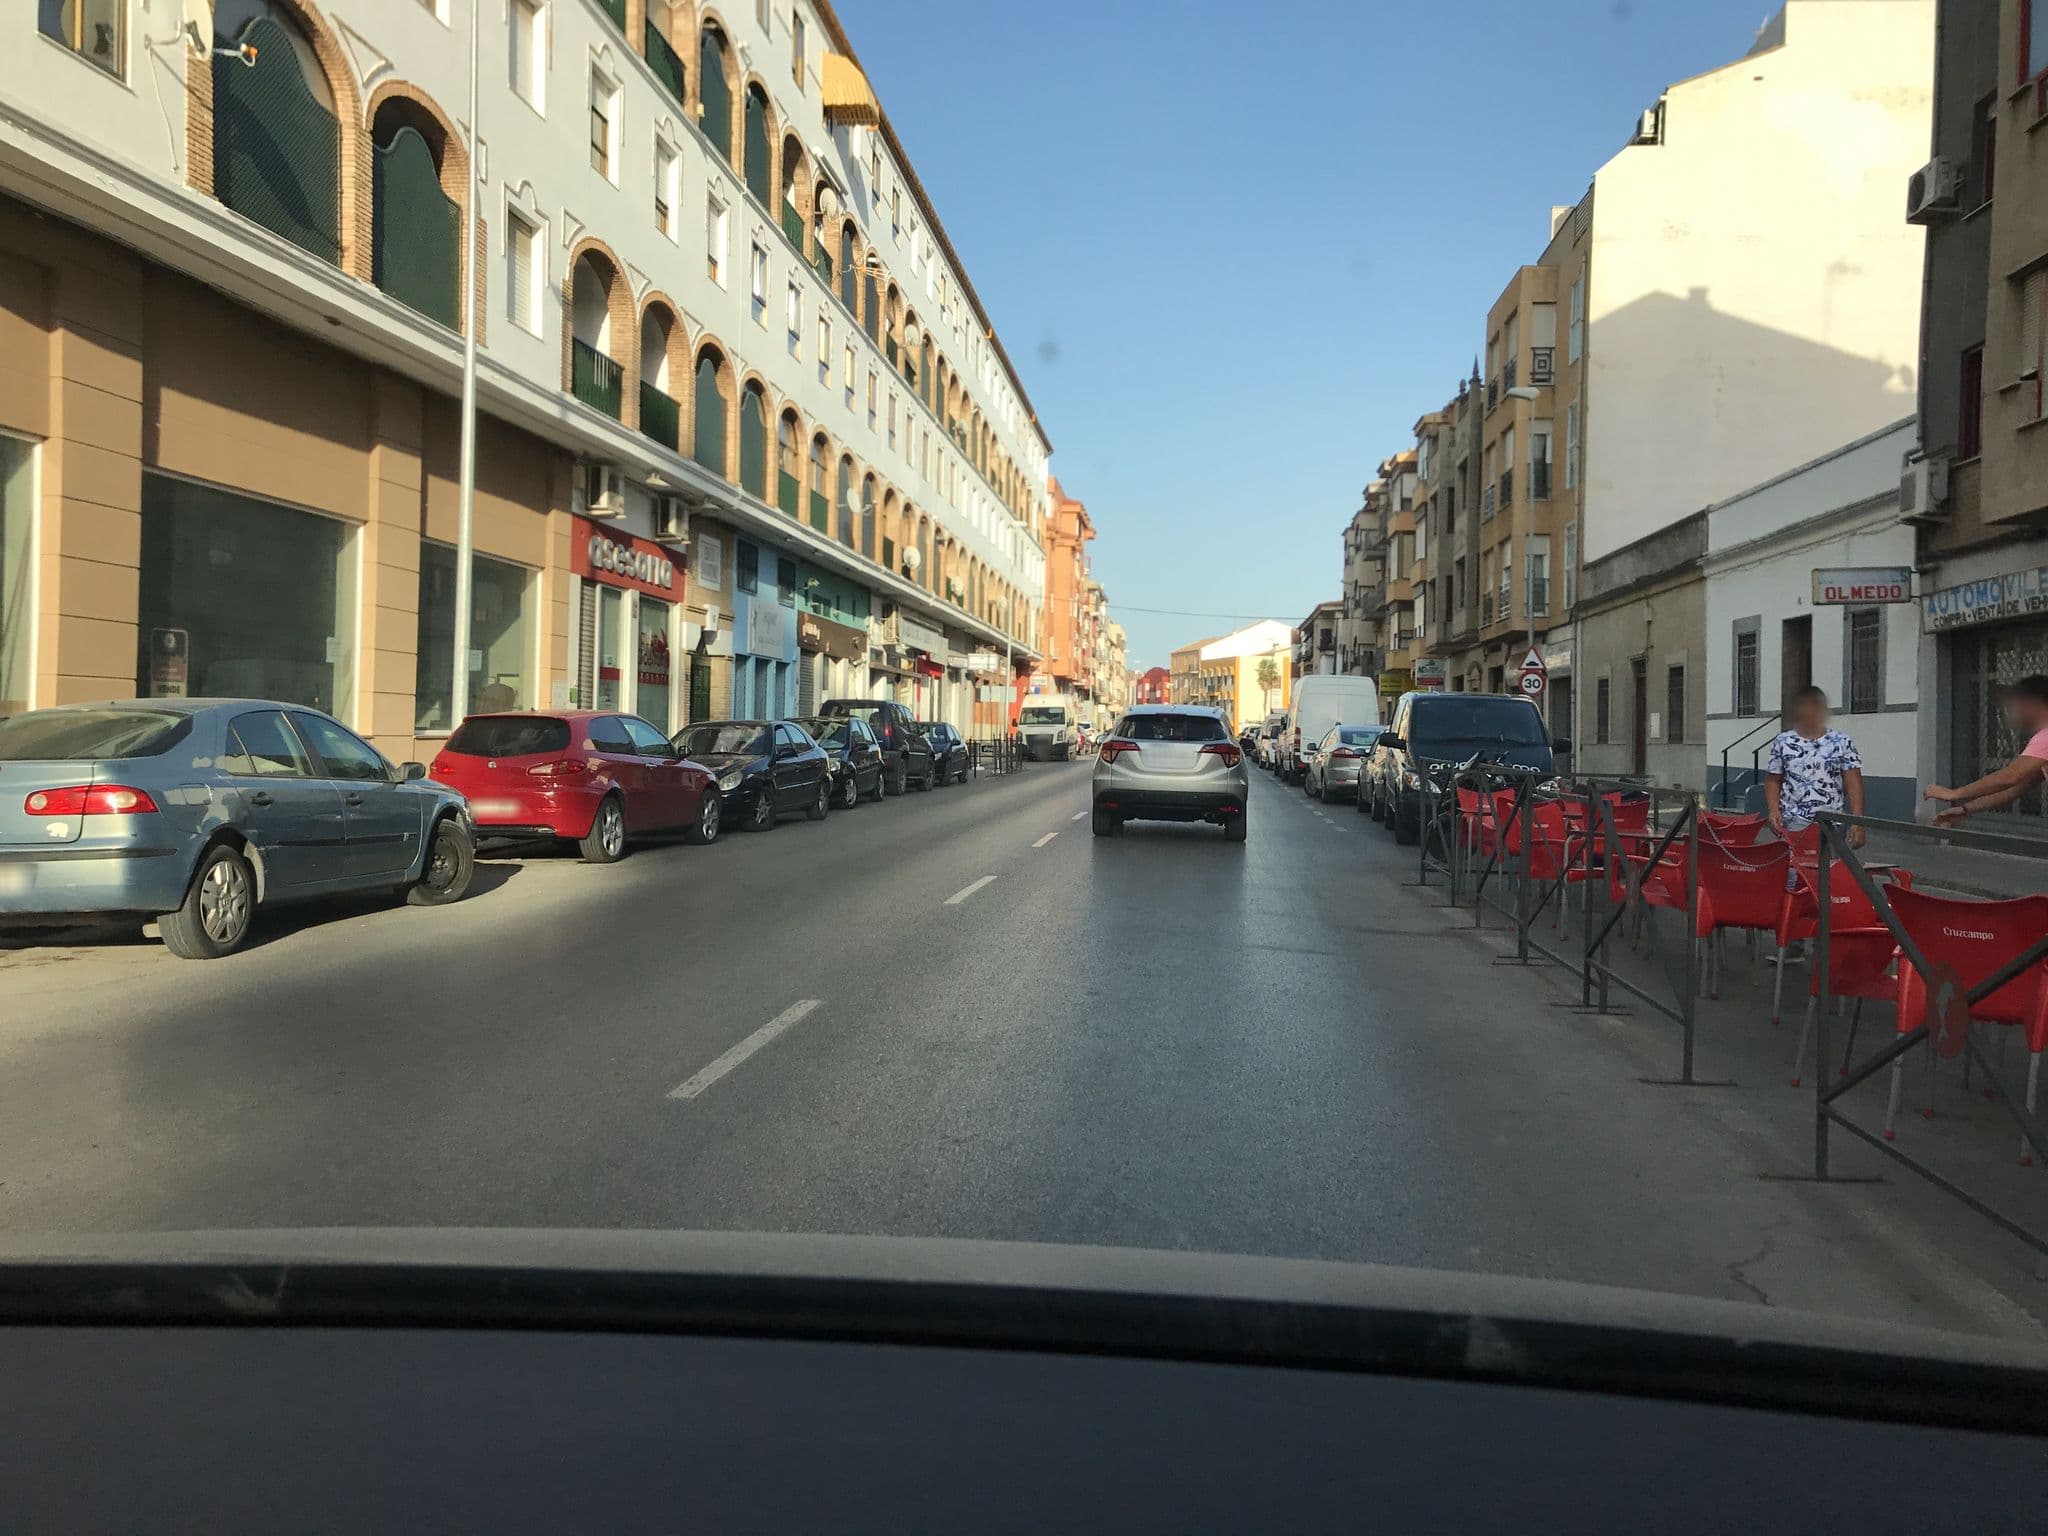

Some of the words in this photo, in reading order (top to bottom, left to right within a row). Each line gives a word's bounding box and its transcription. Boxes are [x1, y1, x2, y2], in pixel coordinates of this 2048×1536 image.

[1824, 584, 1902, 600] OLMEDO
[2006, 599, 2020, 614] DE
[1524, 678, 1541, 689] 30
[1942, 926, 1994, 941] Cruzcampo
